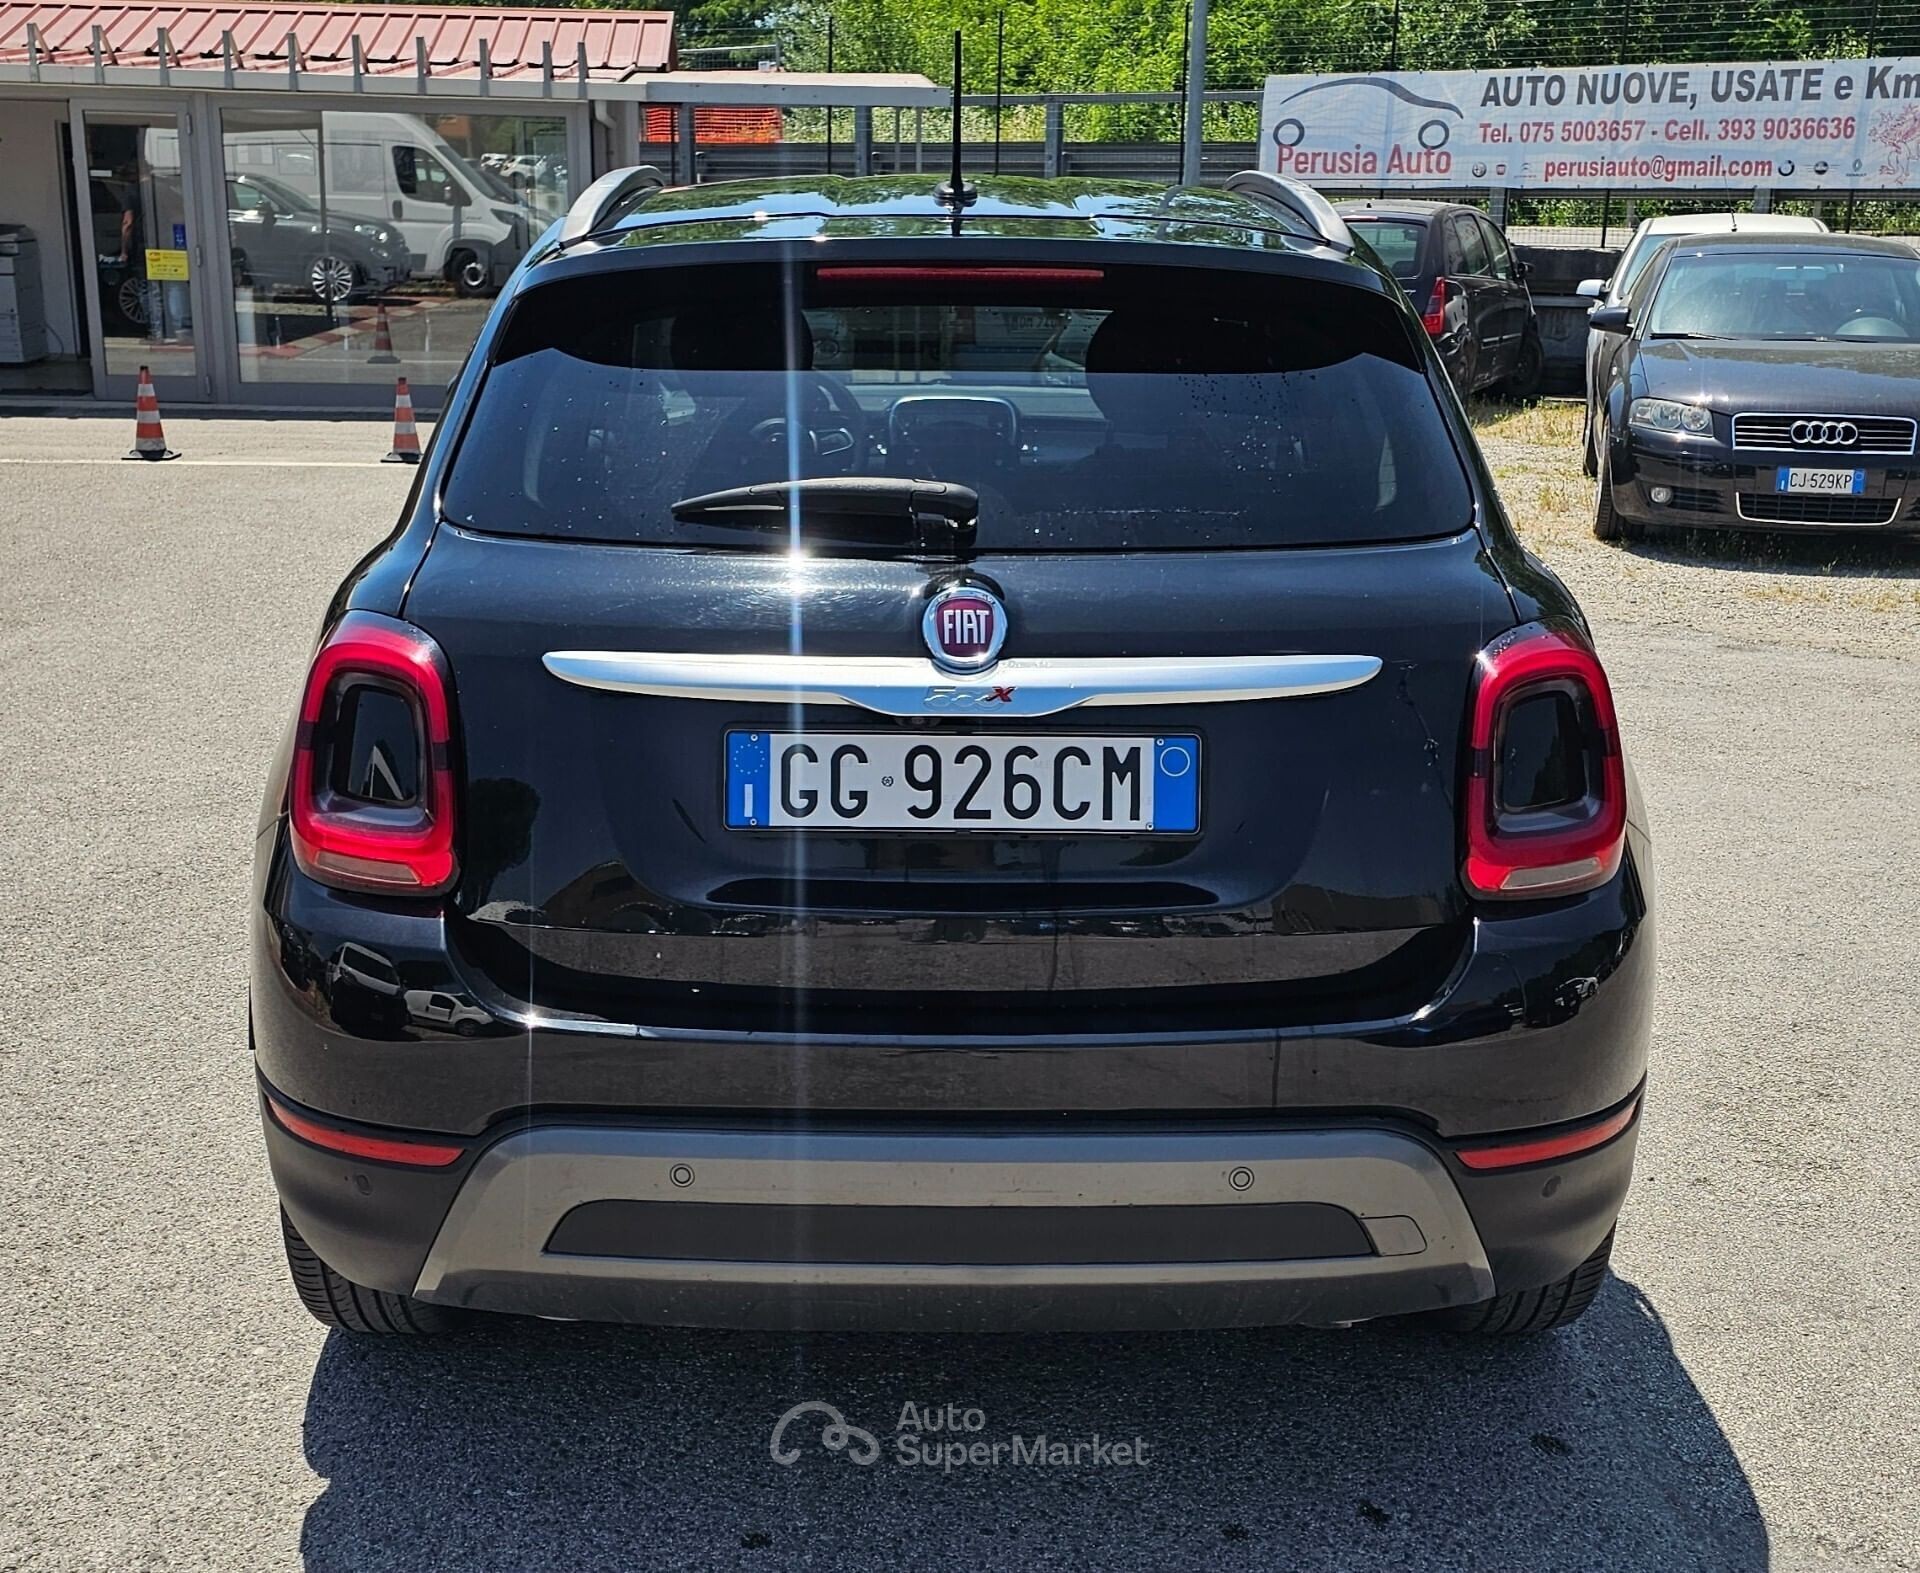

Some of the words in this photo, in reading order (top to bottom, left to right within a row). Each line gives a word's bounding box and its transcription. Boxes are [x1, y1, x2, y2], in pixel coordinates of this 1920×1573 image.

[1480, 74, 1566, 107] AUTO
[1576, 70, 1698, 110] NUOVE,
[1711, 67, 1825, 103] USATE
[1834, 75, 1854, 100] e
[1865, 65, 1920, 99] Km
[1479, 122, 1513, 143] Tel.
[1519, 121, 1554, 143] 075
[1561, 119, 1646, 142] 5003657
[1664, 119, 1710, 141] Cell.
[1717, 117, 1756, 140] 393
[1763, 116, 1856, 140] 9036636
[1277, 143, 1377, 174] Perusia
[1386, 143, 1452, 174] Auto
[1544, 155, 1773, 182] perusiauto@gmail.com
[943, 609, 989, 645] FIAT
[780, 743, 869, 819] GG
[903, 744, 1142, 821] 926CM
